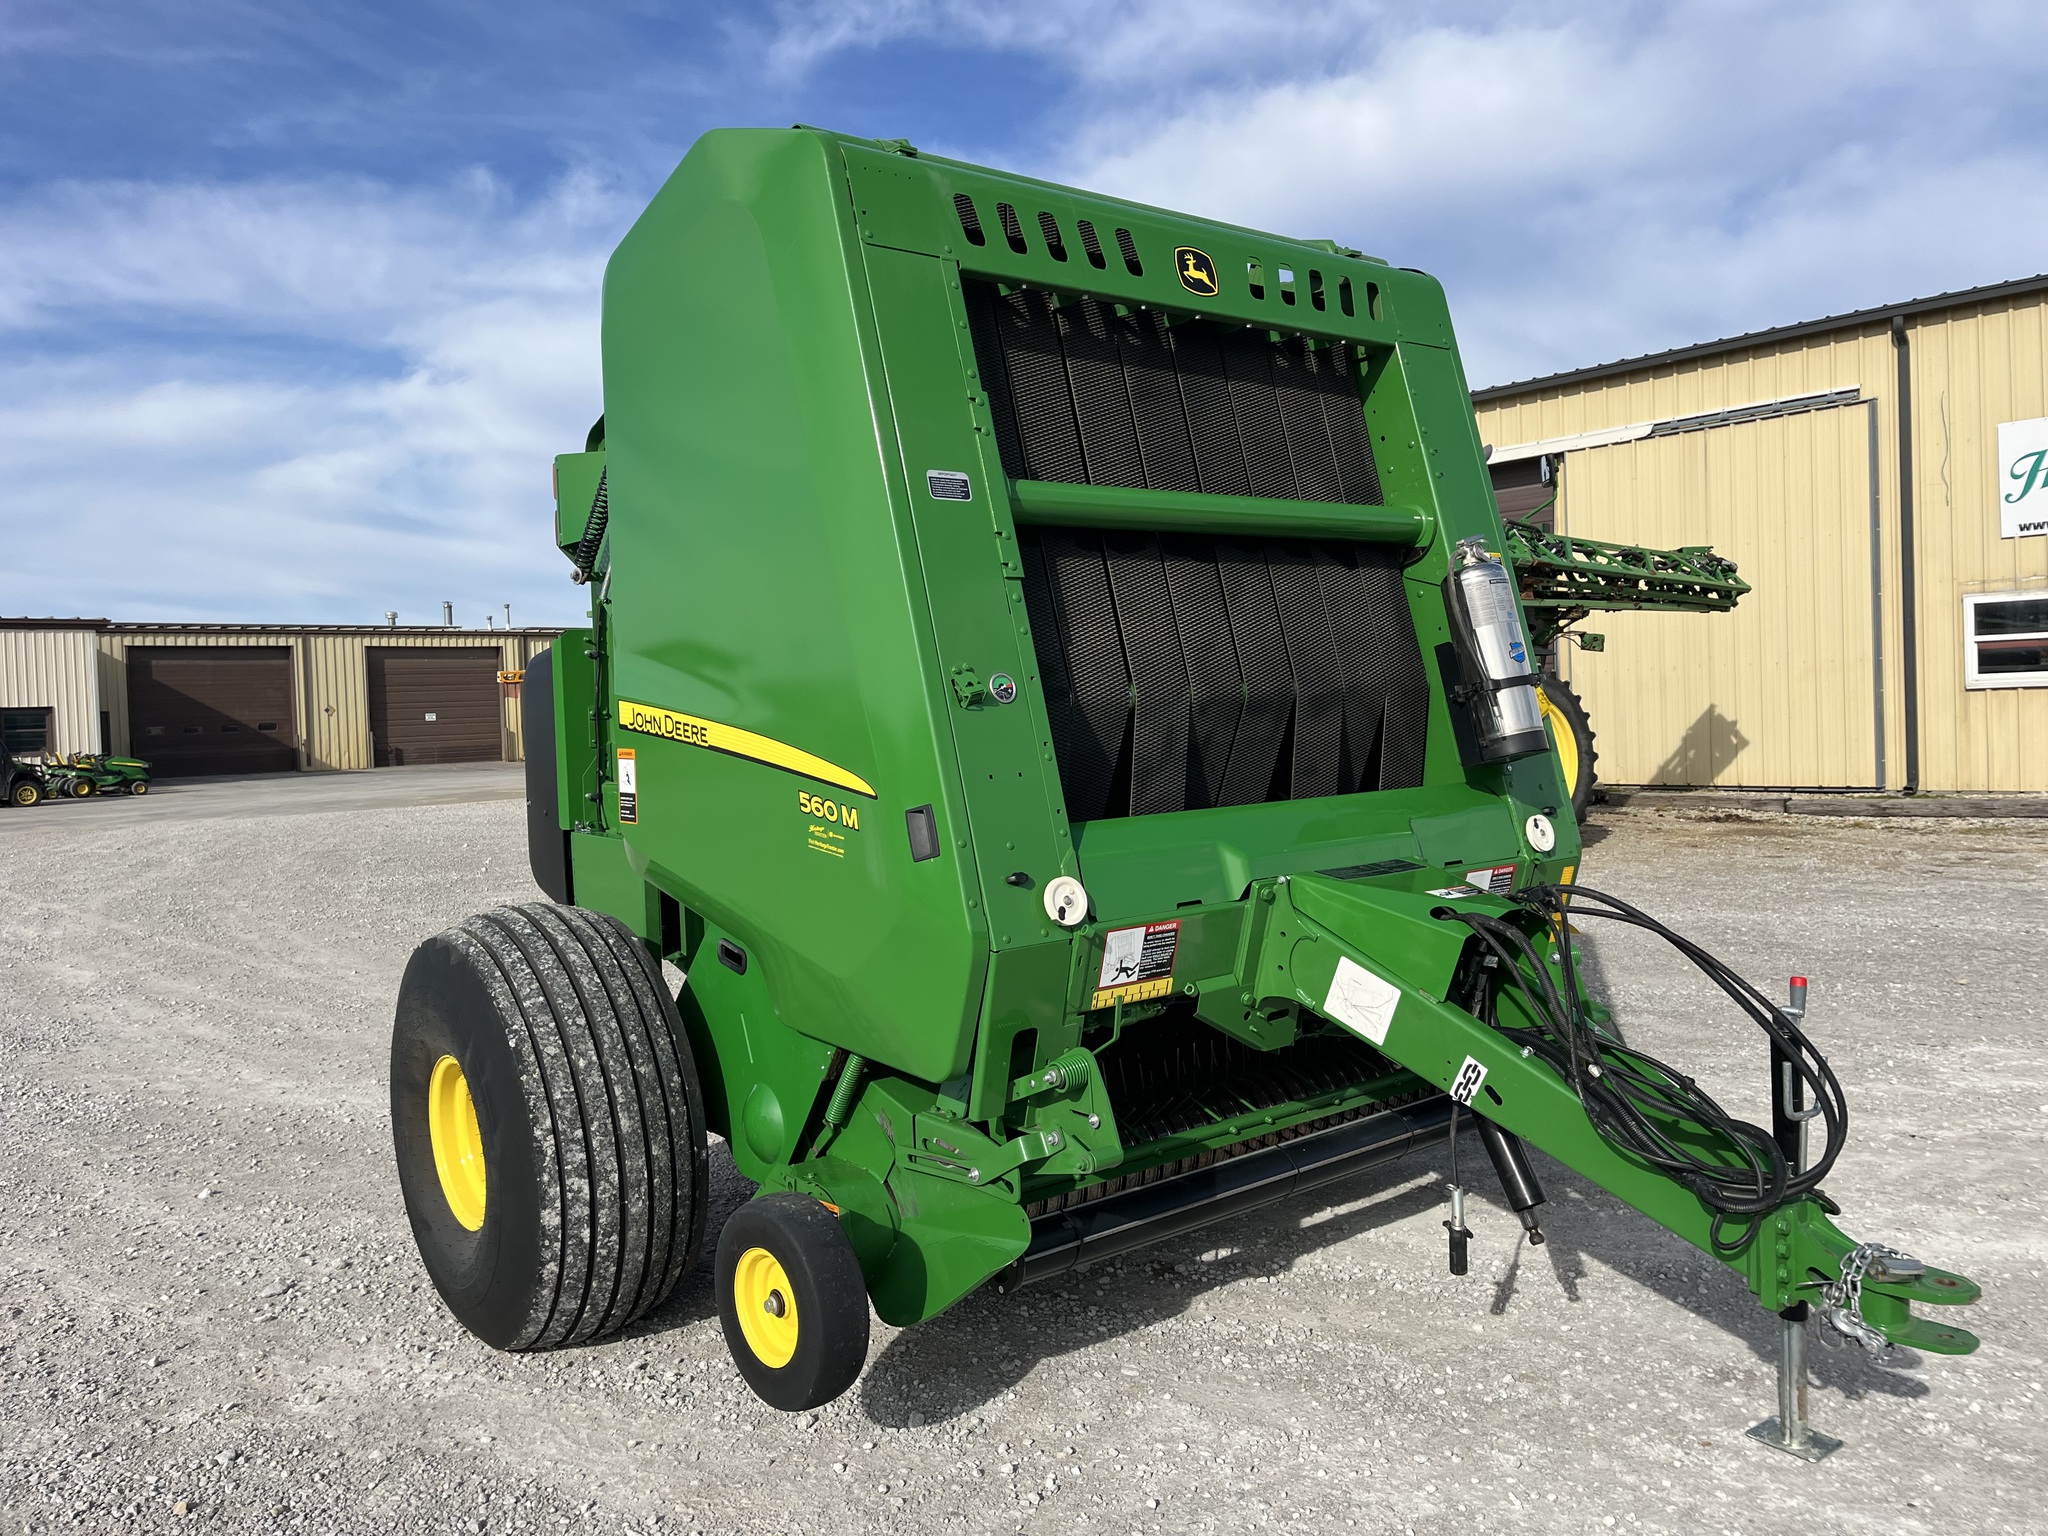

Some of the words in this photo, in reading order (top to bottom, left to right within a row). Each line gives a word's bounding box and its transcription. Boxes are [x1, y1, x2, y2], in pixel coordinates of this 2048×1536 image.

[2018, 521, 2048, 532] ww
[629, 708, 662, 732] JOHN
[664, 715, 708, 743] DEERE
[798, 790, 838, 823] 560
[841, 803, 859, 831] M
[1155, 923, 1177, 931] DANGER
